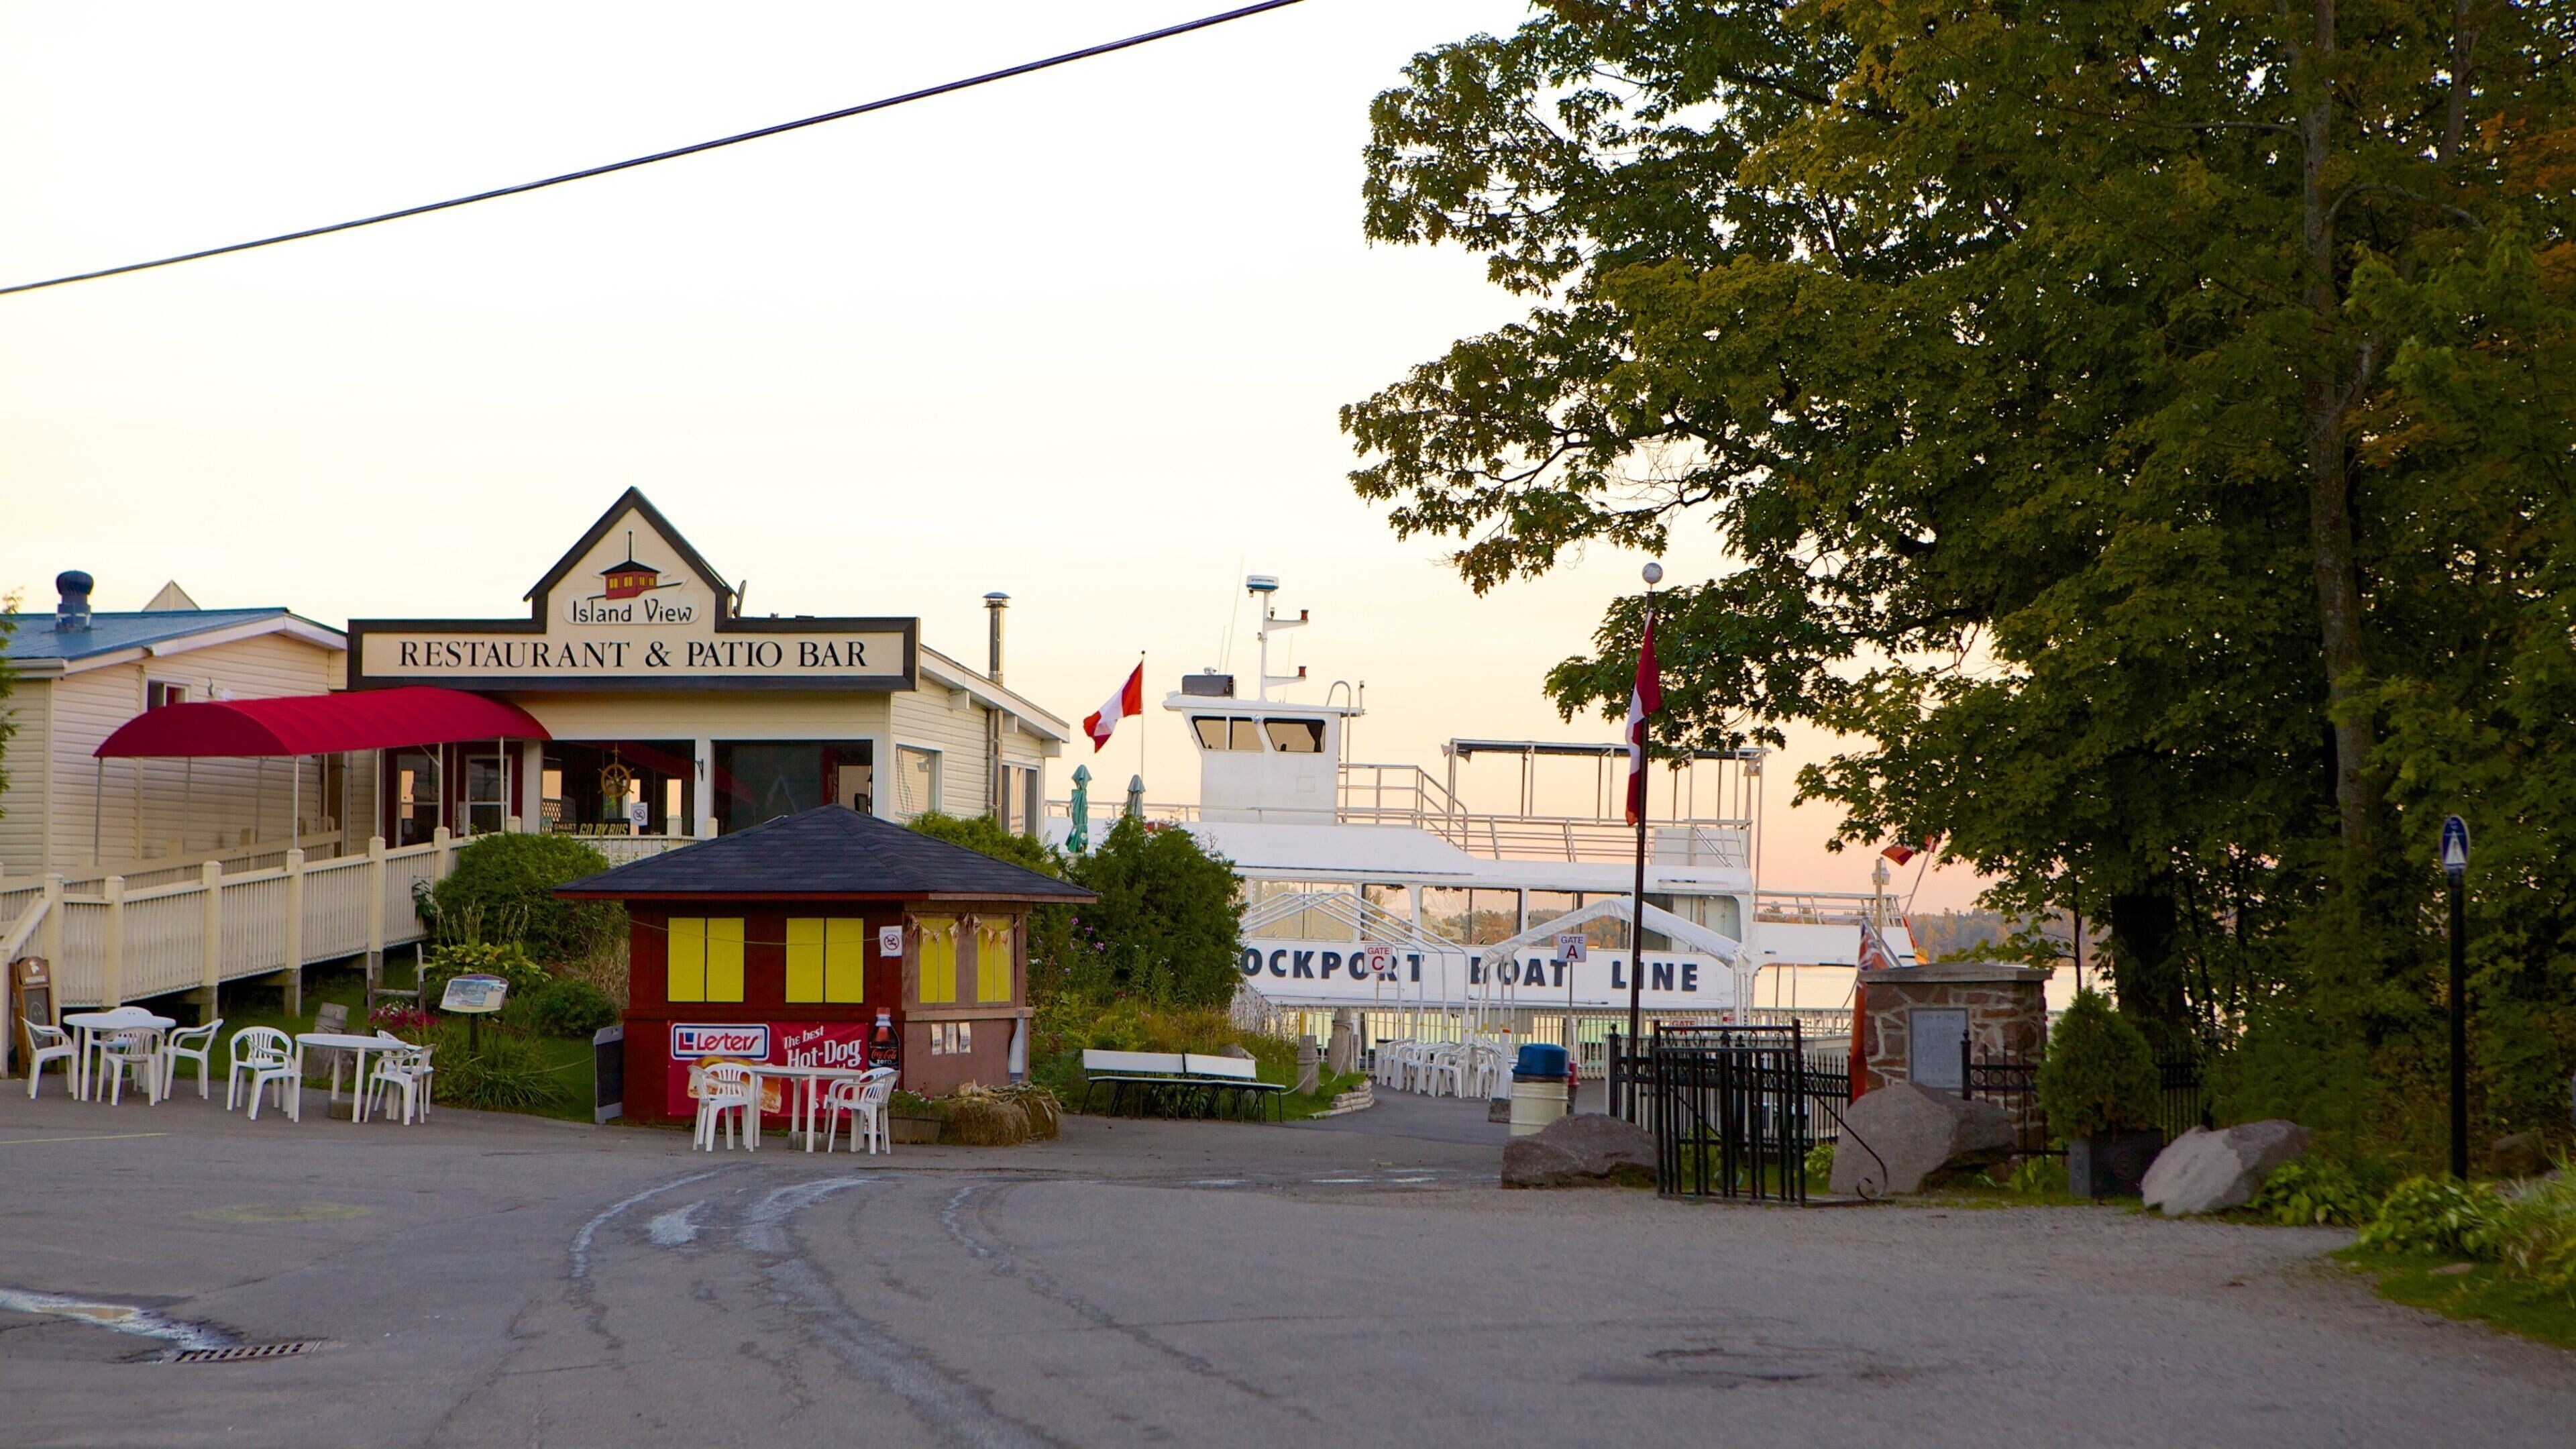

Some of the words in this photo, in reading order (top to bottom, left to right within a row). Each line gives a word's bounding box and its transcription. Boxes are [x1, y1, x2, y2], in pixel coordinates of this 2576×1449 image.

[572, 600, 632, 623] Island
[644, 598, 693, 623] View
[398, 640, 631, 668] RESTAURANT
[645, 640, 672, 667] &
[685, 640, 784, 668] PATIO
[796, 640, 868, 667] BAR
[579, 822, 594, 835] GO
[594, 822, 608, 835] BY
[608, 822, 629, 835] BUS
[1560, 936, 1584, 944] GATE
[1566, 945, 1578, 959] A
[1371, 955, 1385, 971] C
[1611, 960, 1698, 991] LINE
[783, 1035, 800, 1050] The
[802, 1025, 824, 1042] best
[787, 1039, 862, 1068] Hot-Dog
